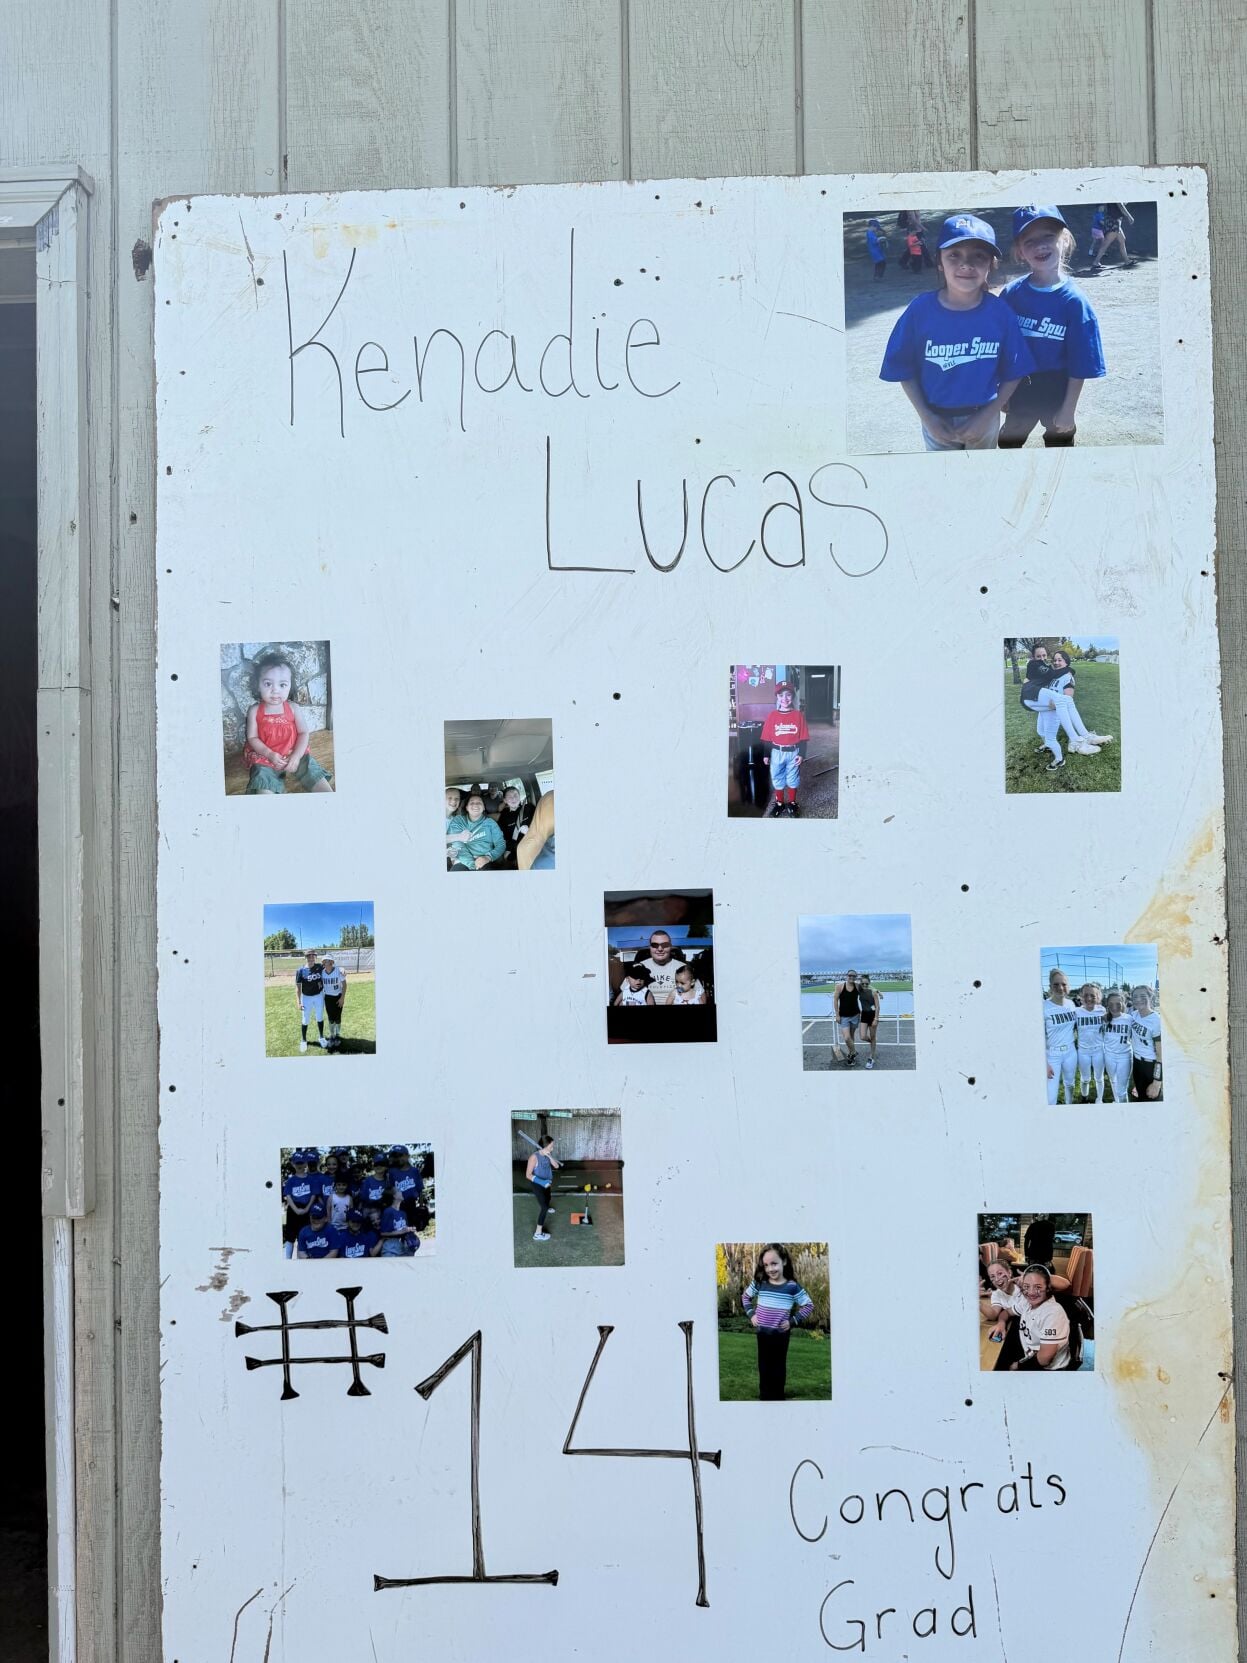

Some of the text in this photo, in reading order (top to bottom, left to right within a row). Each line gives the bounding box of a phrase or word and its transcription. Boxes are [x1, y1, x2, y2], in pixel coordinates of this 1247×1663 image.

[925, 337, 1000, 361] Cooper Spur
[547, 436, 889, 577] Lucas
[235, 1286, 722, 1608] #14
[789, 1459, 1067, 1580] Congrats
[819, 1579, 978, 1653] Grad
